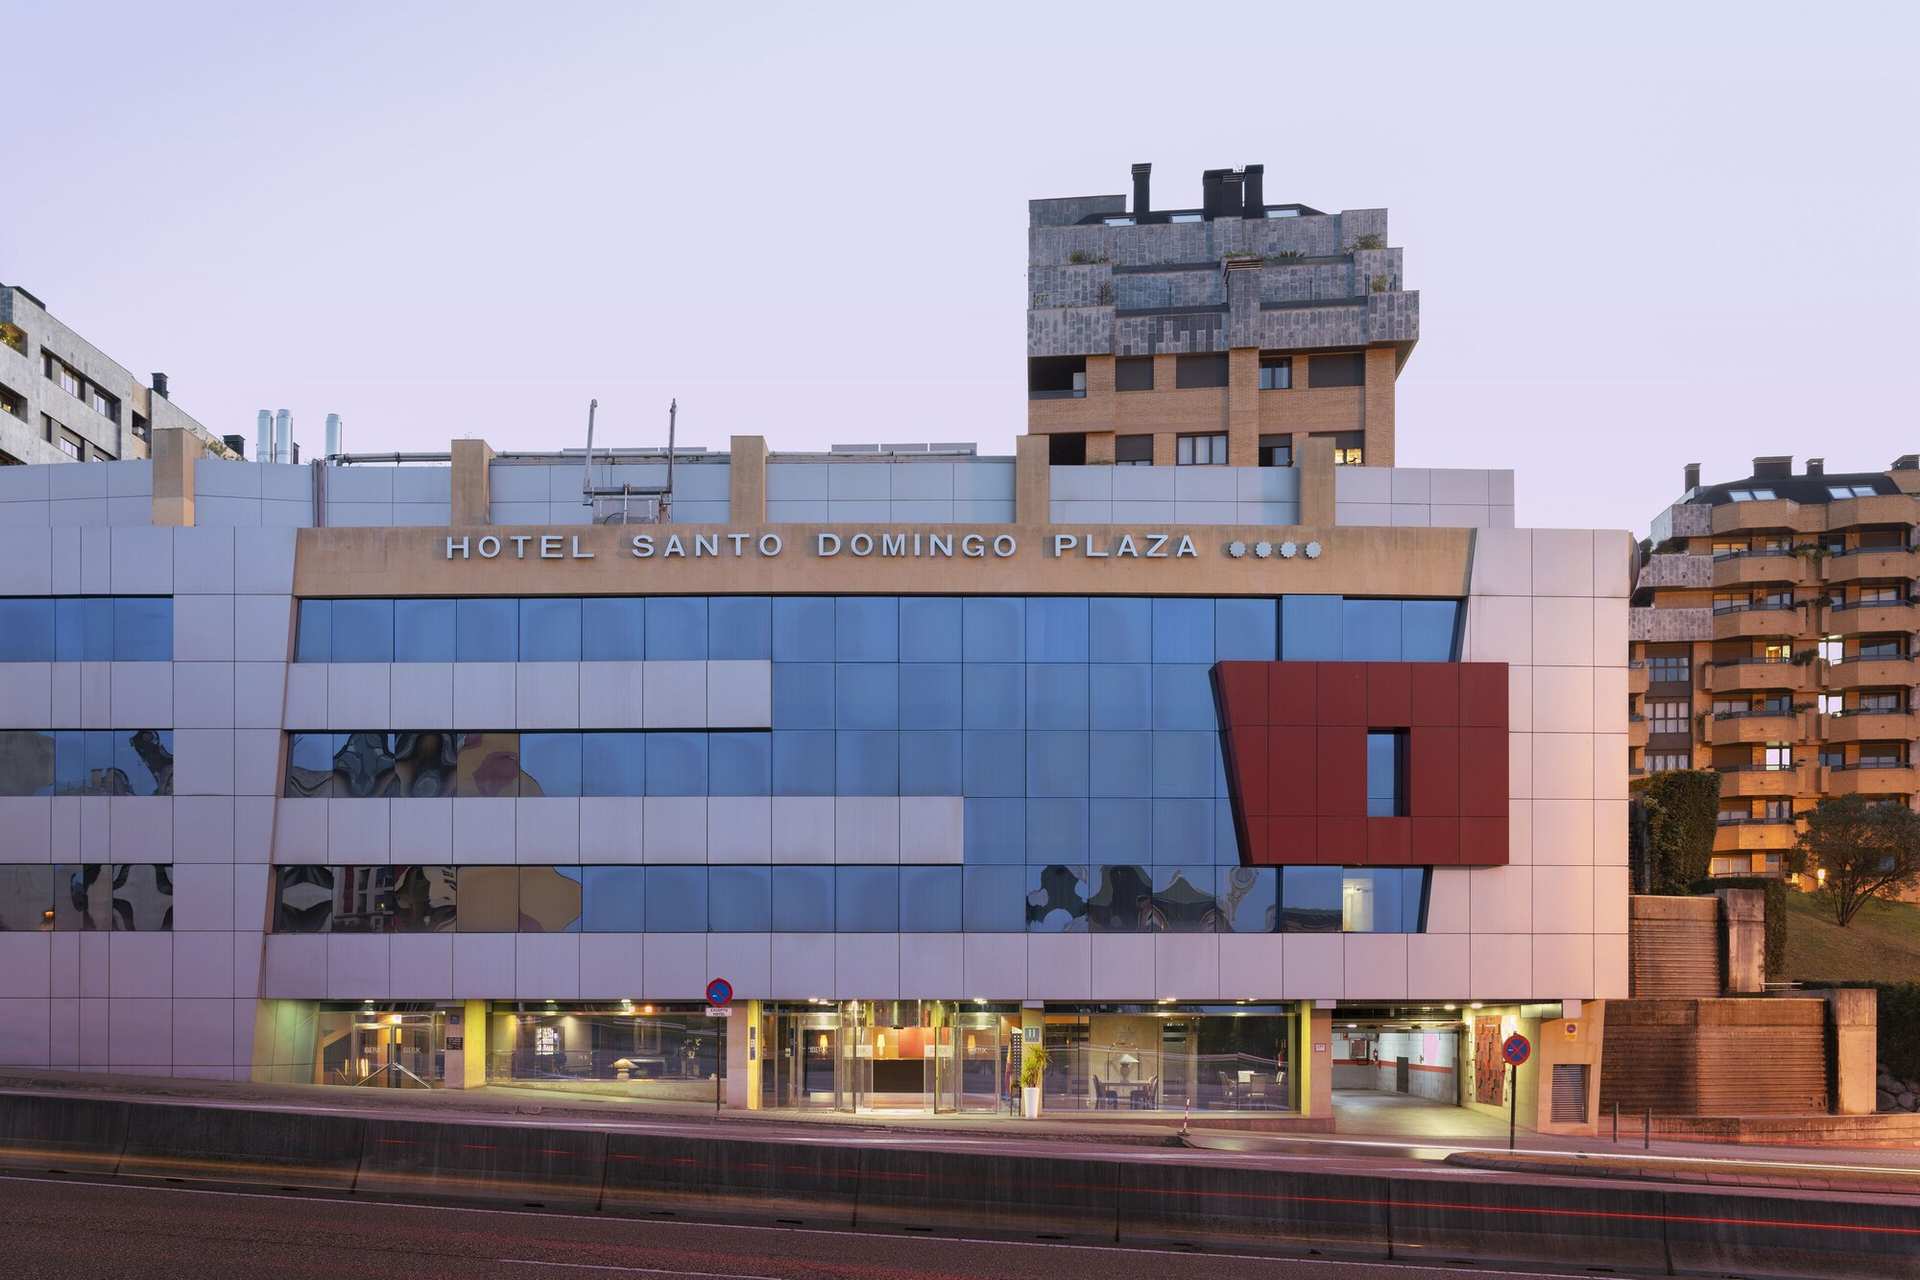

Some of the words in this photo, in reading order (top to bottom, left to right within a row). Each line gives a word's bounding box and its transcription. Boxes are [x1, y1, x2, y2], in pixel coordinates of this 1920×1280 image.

[446, 535, 594, 558] HOTEL
[631, 533, 783, 557] SANTO
[817, 533, 1017, 557] DOMINGO
[1054, 534, 1198, 557] PLAZA
